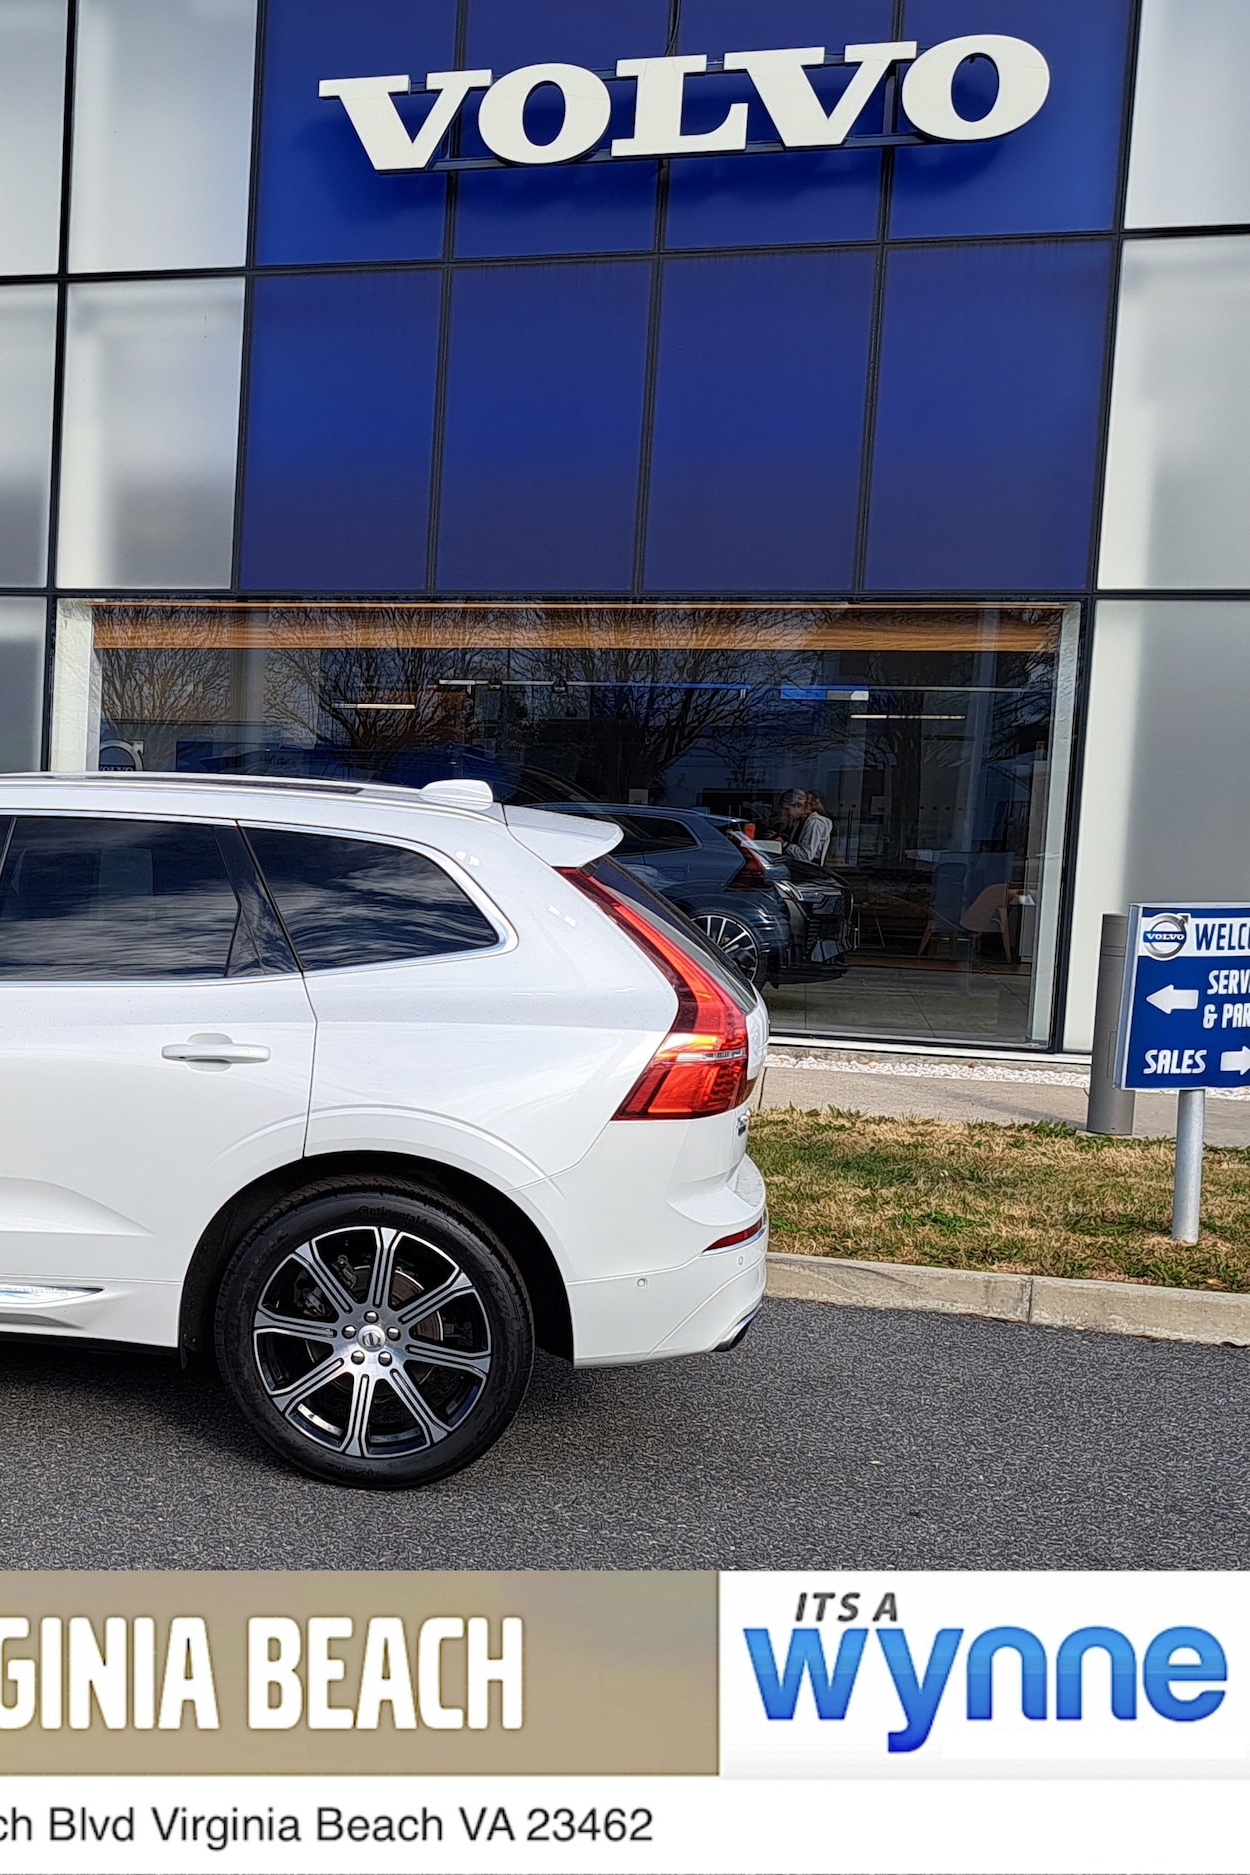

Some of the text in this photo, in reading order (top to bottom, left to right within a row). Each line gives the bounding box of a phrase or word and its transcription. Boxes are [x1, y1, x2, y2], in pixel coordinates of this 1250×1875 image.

[318, 34, 1051, 171] VOLVO
[1146, 923, 1250, 951] VOLVO WELC
[1207, 969, 1250, 995] SERV
[1202, 1004, 1218, 1029] &
[1143, 1049, 1207, 1075] SALES
